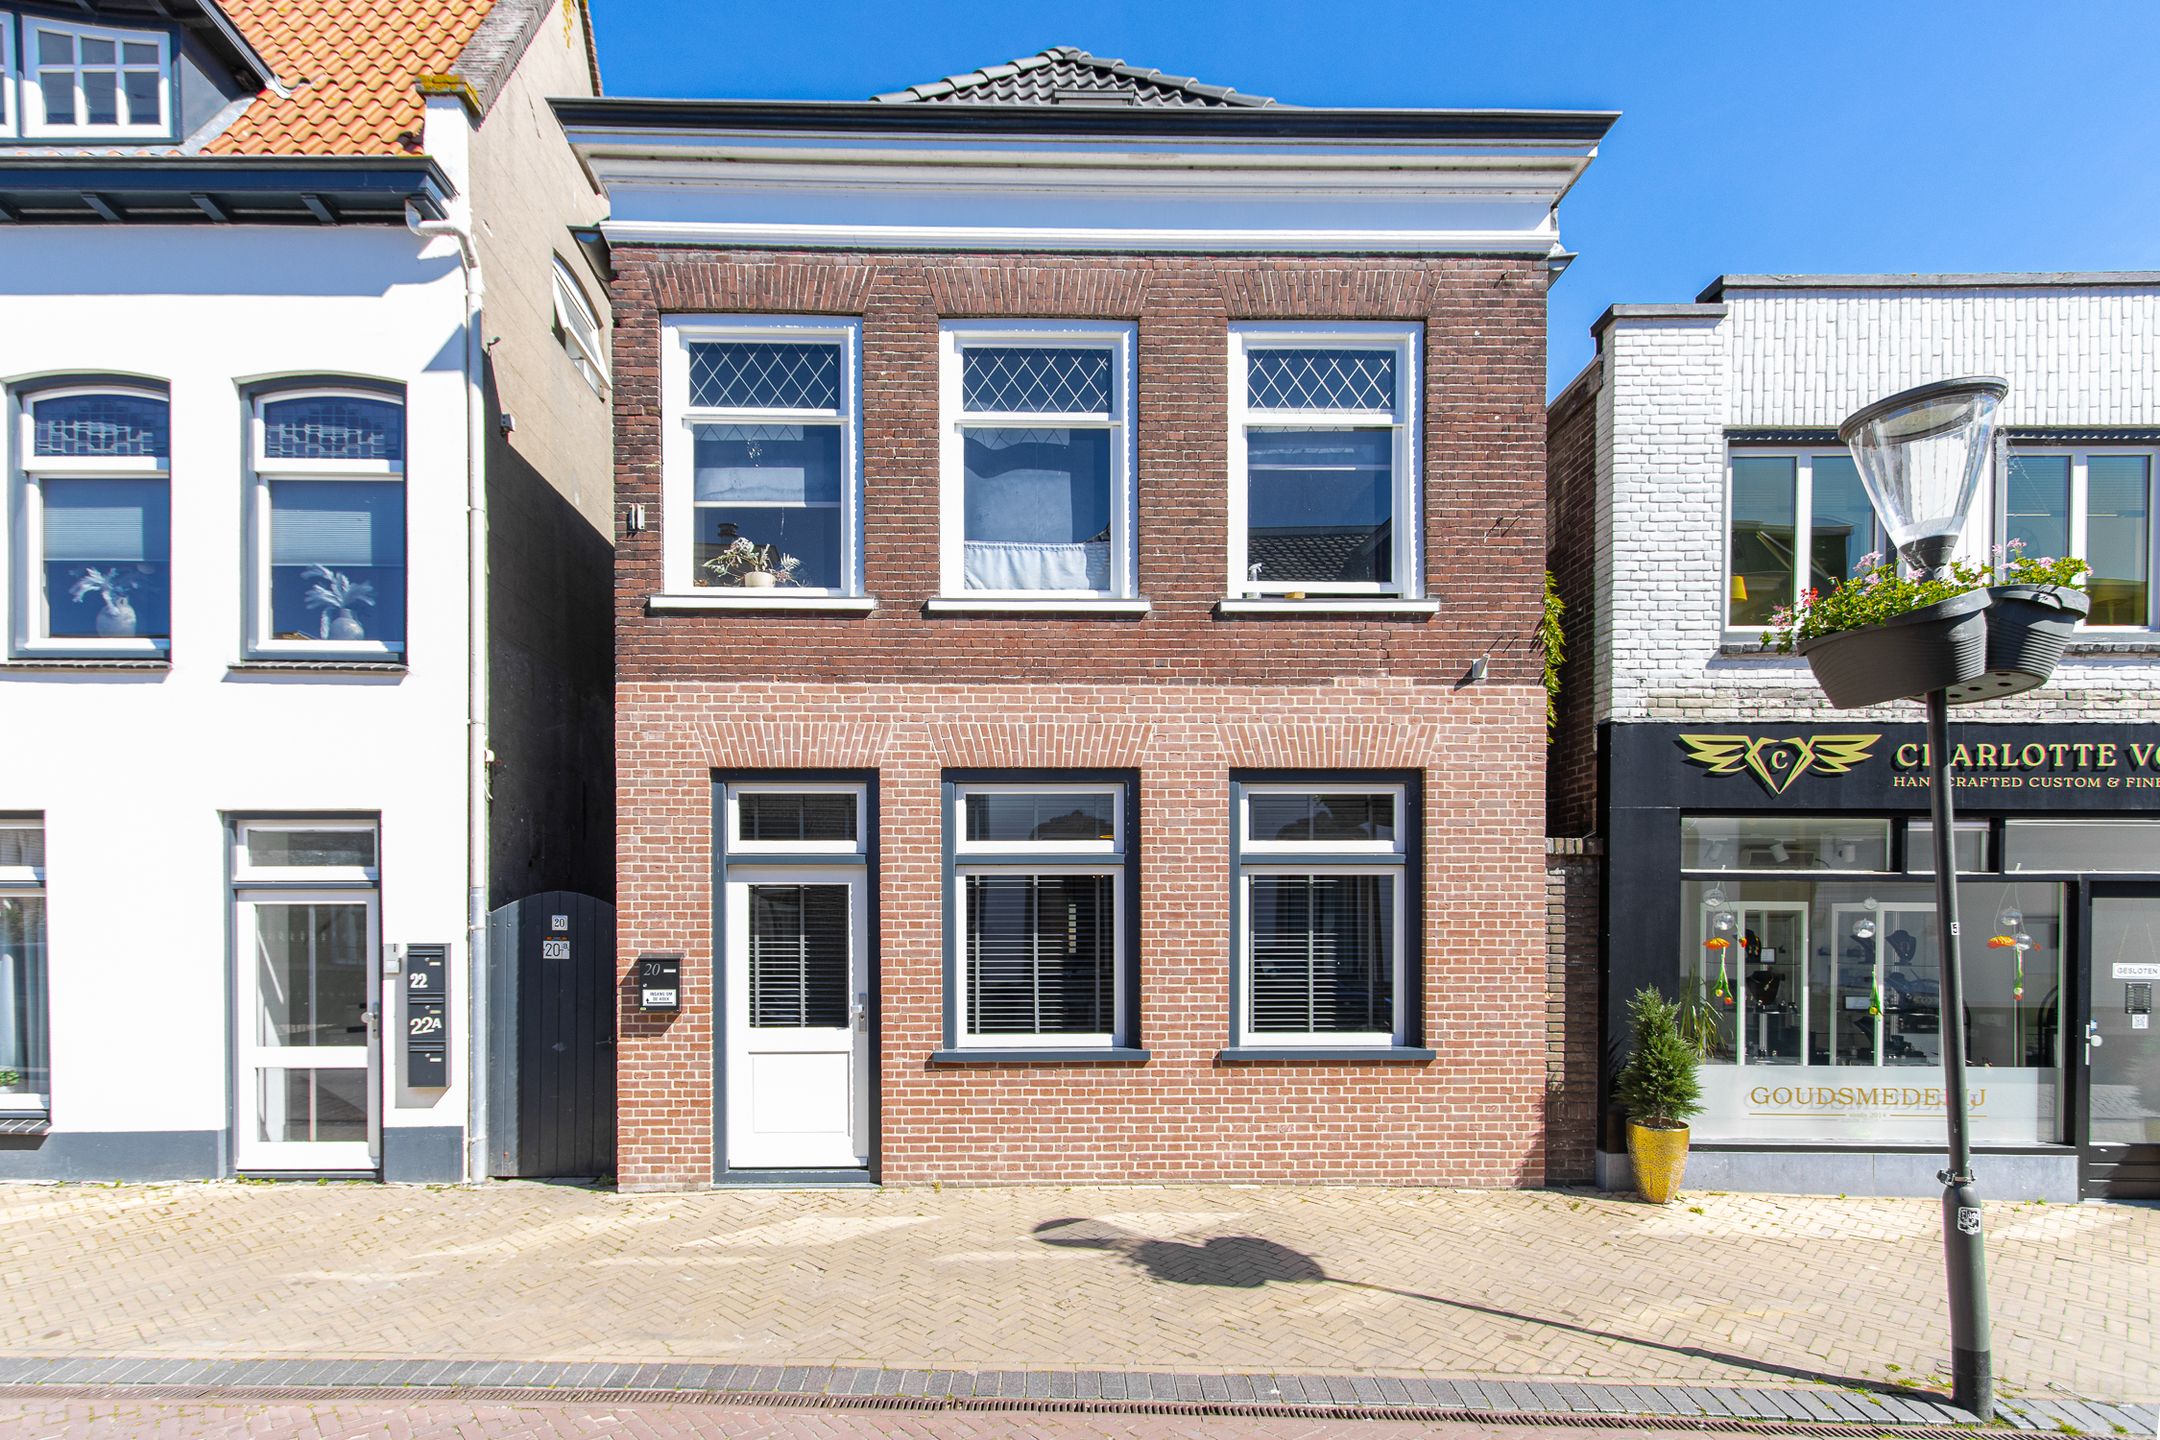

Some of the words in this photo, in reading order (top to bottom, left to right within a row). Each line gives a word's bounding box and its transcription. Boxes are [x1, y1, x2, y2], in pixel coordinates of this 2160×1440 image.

[1771, 750, 1789, 769] C
[2129, 743, 2160, 767] V
[2028, 776, 2102, 788] CUSTOM
[2106, 776, 2120, 788] &
[554, 918, 565, 928] 20
[643, 963, 661, 976] 20
[2116, 967, 2159, 976] GESLOTEN
[409, 972, 428, 989] 22
[409, 1016, 442, 1035] 22A
[1750, 1086, 1987, 1107] GOUDSMEDEJ
